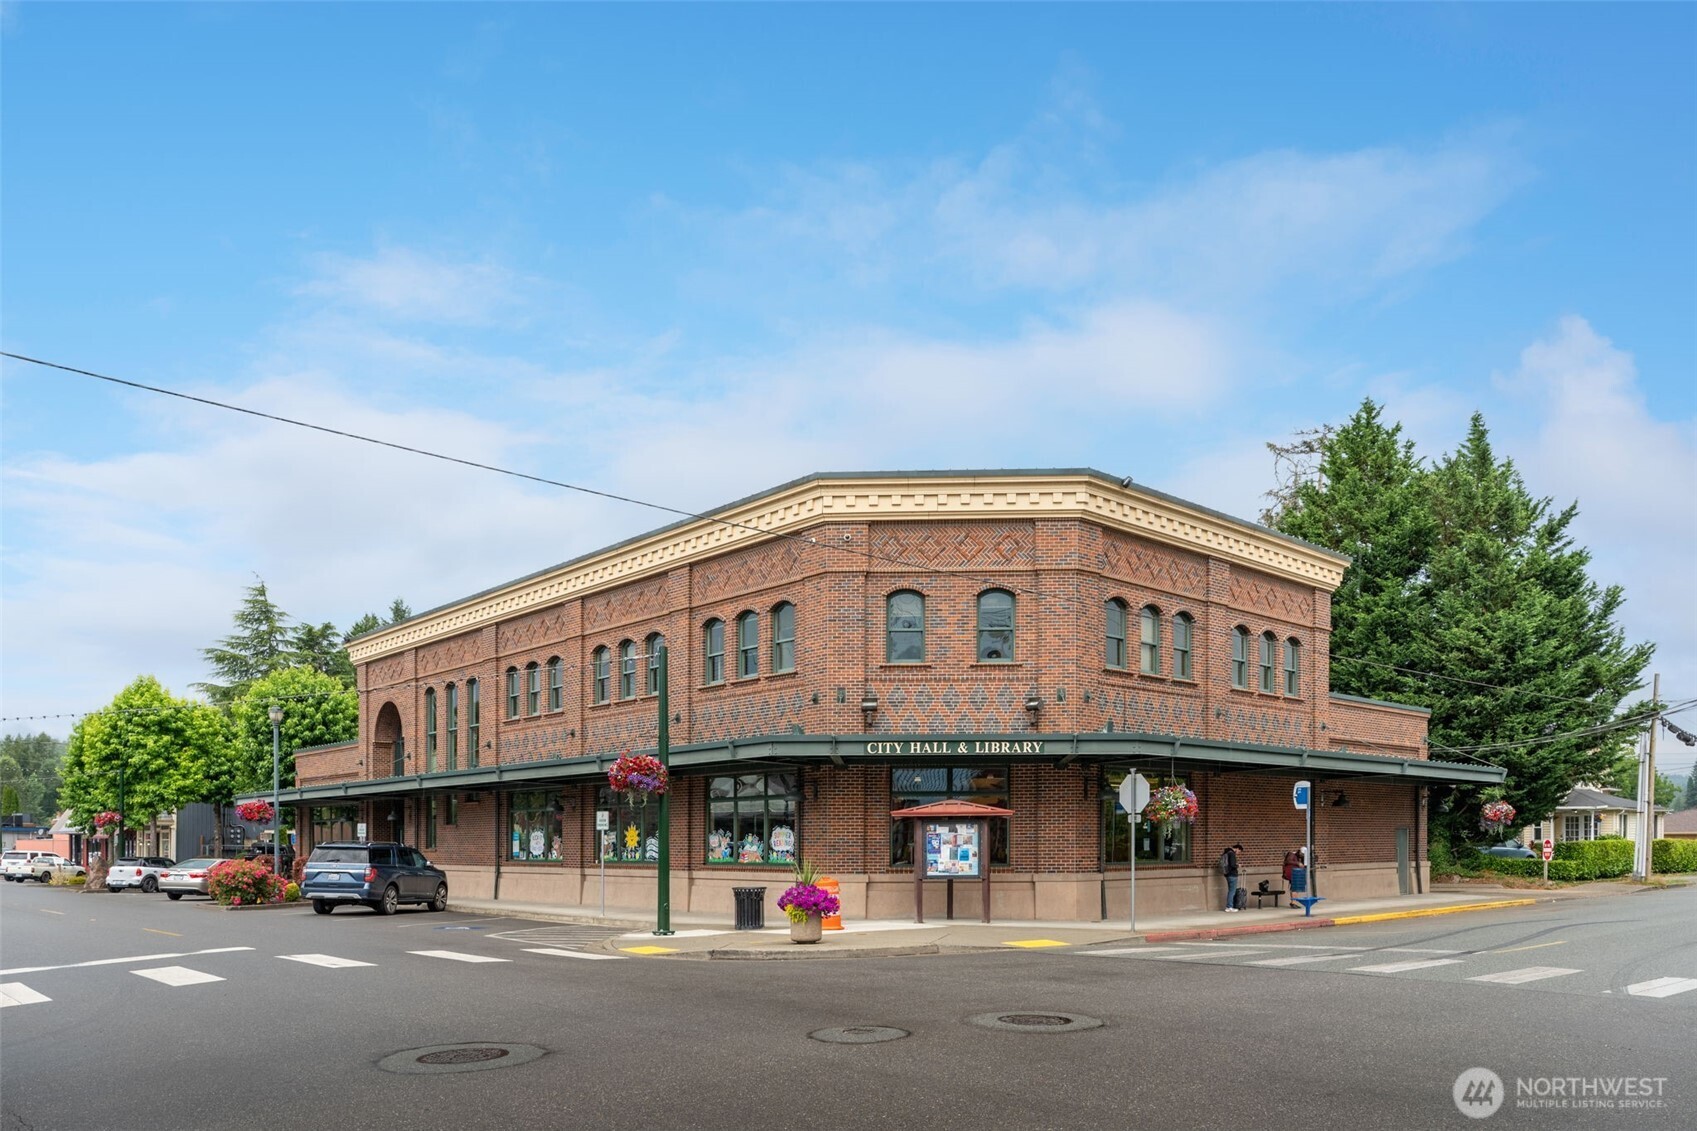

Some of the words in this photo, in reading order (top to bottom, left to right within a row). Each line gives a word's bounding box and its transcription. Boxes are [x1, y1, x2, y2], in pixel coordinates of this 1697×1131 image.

[867, 741, 904, 754] CITY
[910, 741, 951, 754] HALL
[957, 741, 969, 754] &
[975, 741, 1043, 754] LIBRARY
